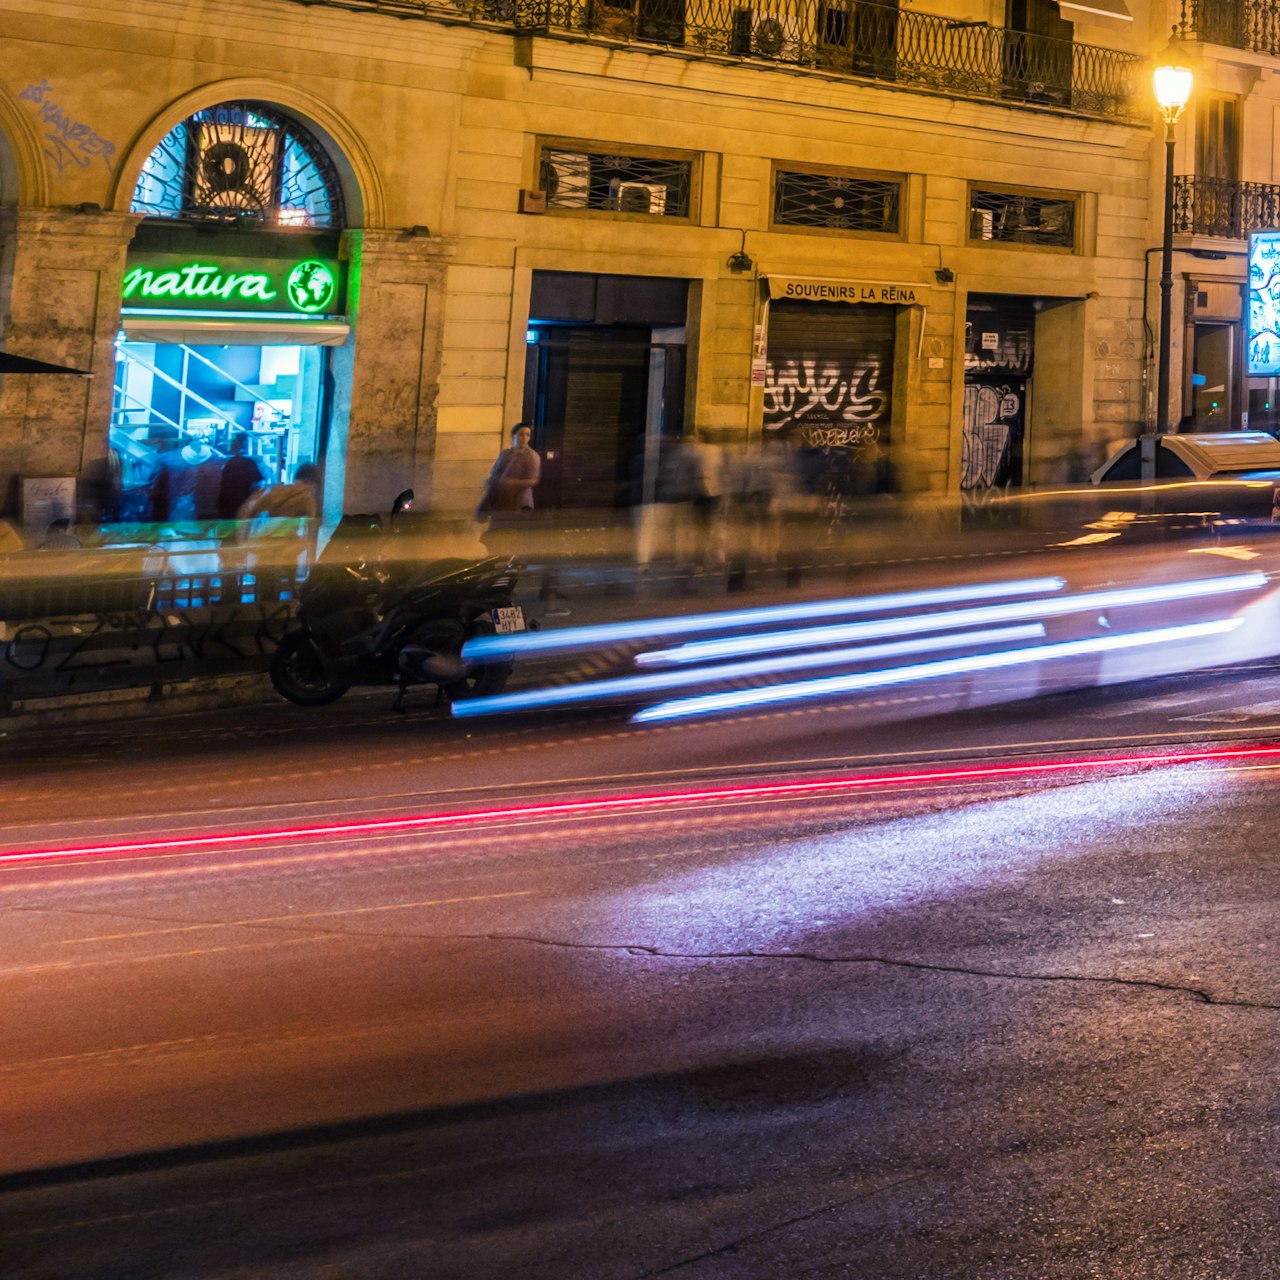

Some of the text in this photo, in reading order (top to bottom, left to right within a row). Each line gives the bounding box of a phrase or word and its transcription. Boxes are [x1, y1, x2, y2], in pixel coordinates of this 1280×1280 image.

[122, 264, 277, 300] natura
[786, 283, 855, 298] SOUVENIRS
[861, 287, 876, 300] LA
